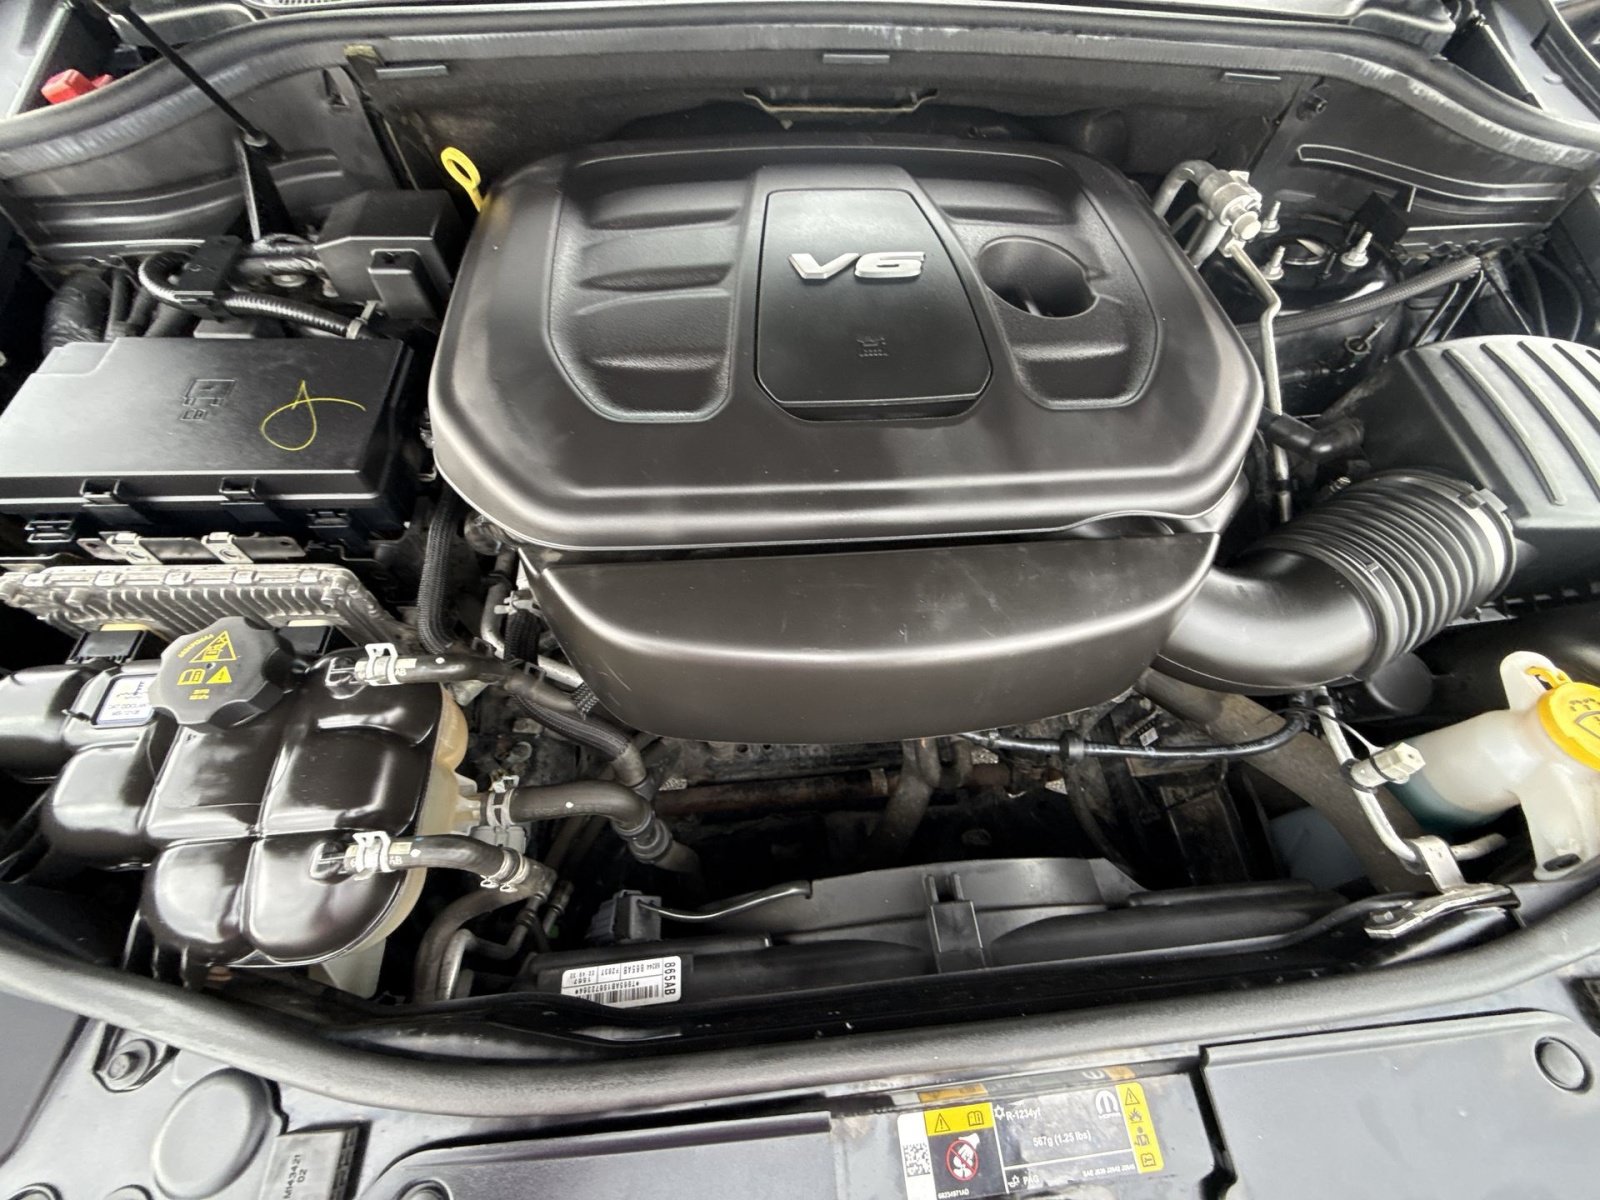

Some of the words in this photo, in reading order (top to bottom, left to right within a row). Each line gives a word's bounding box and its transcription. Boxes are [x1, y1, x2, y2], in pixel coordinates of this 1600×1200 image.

[788, 251, 925, 280] V6
[664, 961, 676, 996] 865AB
[1005, 1107, 1041, 1122] R-1234yf
[1032, 1134, 1053, 1148] 567g
[1054, 1131, 1074, 1147] (1.25
[1074, 1129, 1092, 1143] lbs)
[1022, 1174, 1040, 1186] PAG
